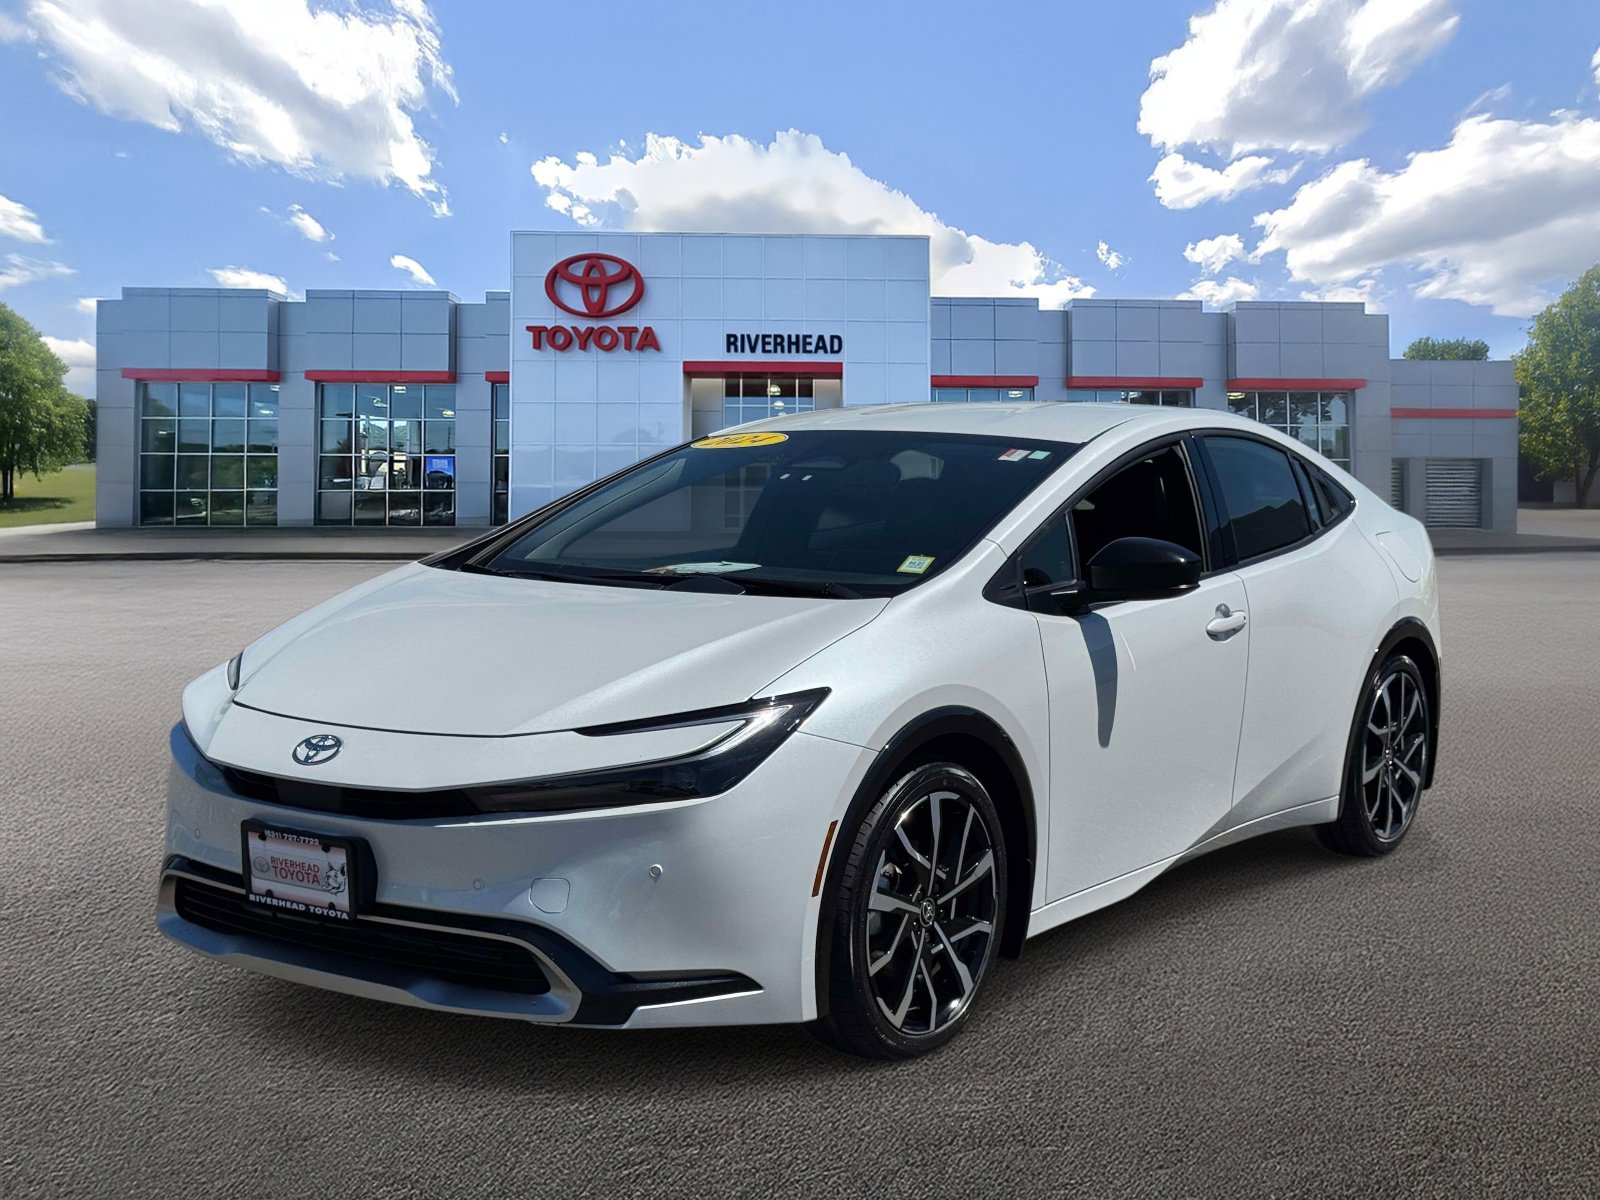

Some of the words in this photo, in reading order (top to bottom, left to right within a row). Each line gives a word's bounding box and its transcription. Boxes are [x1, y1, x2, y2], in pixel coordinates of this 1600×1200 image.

[526, 325, 661, 352] TOYOTA
[725, 333, 843, 355] RIVERHEAD
[271, 856, 320, 873] RIVERHEAD
[272, 866, 320, 885] TOYOTA
[249, 894, 306, 911] RIVERHEAD
[309, 906, 349, 920] TOYOTA
